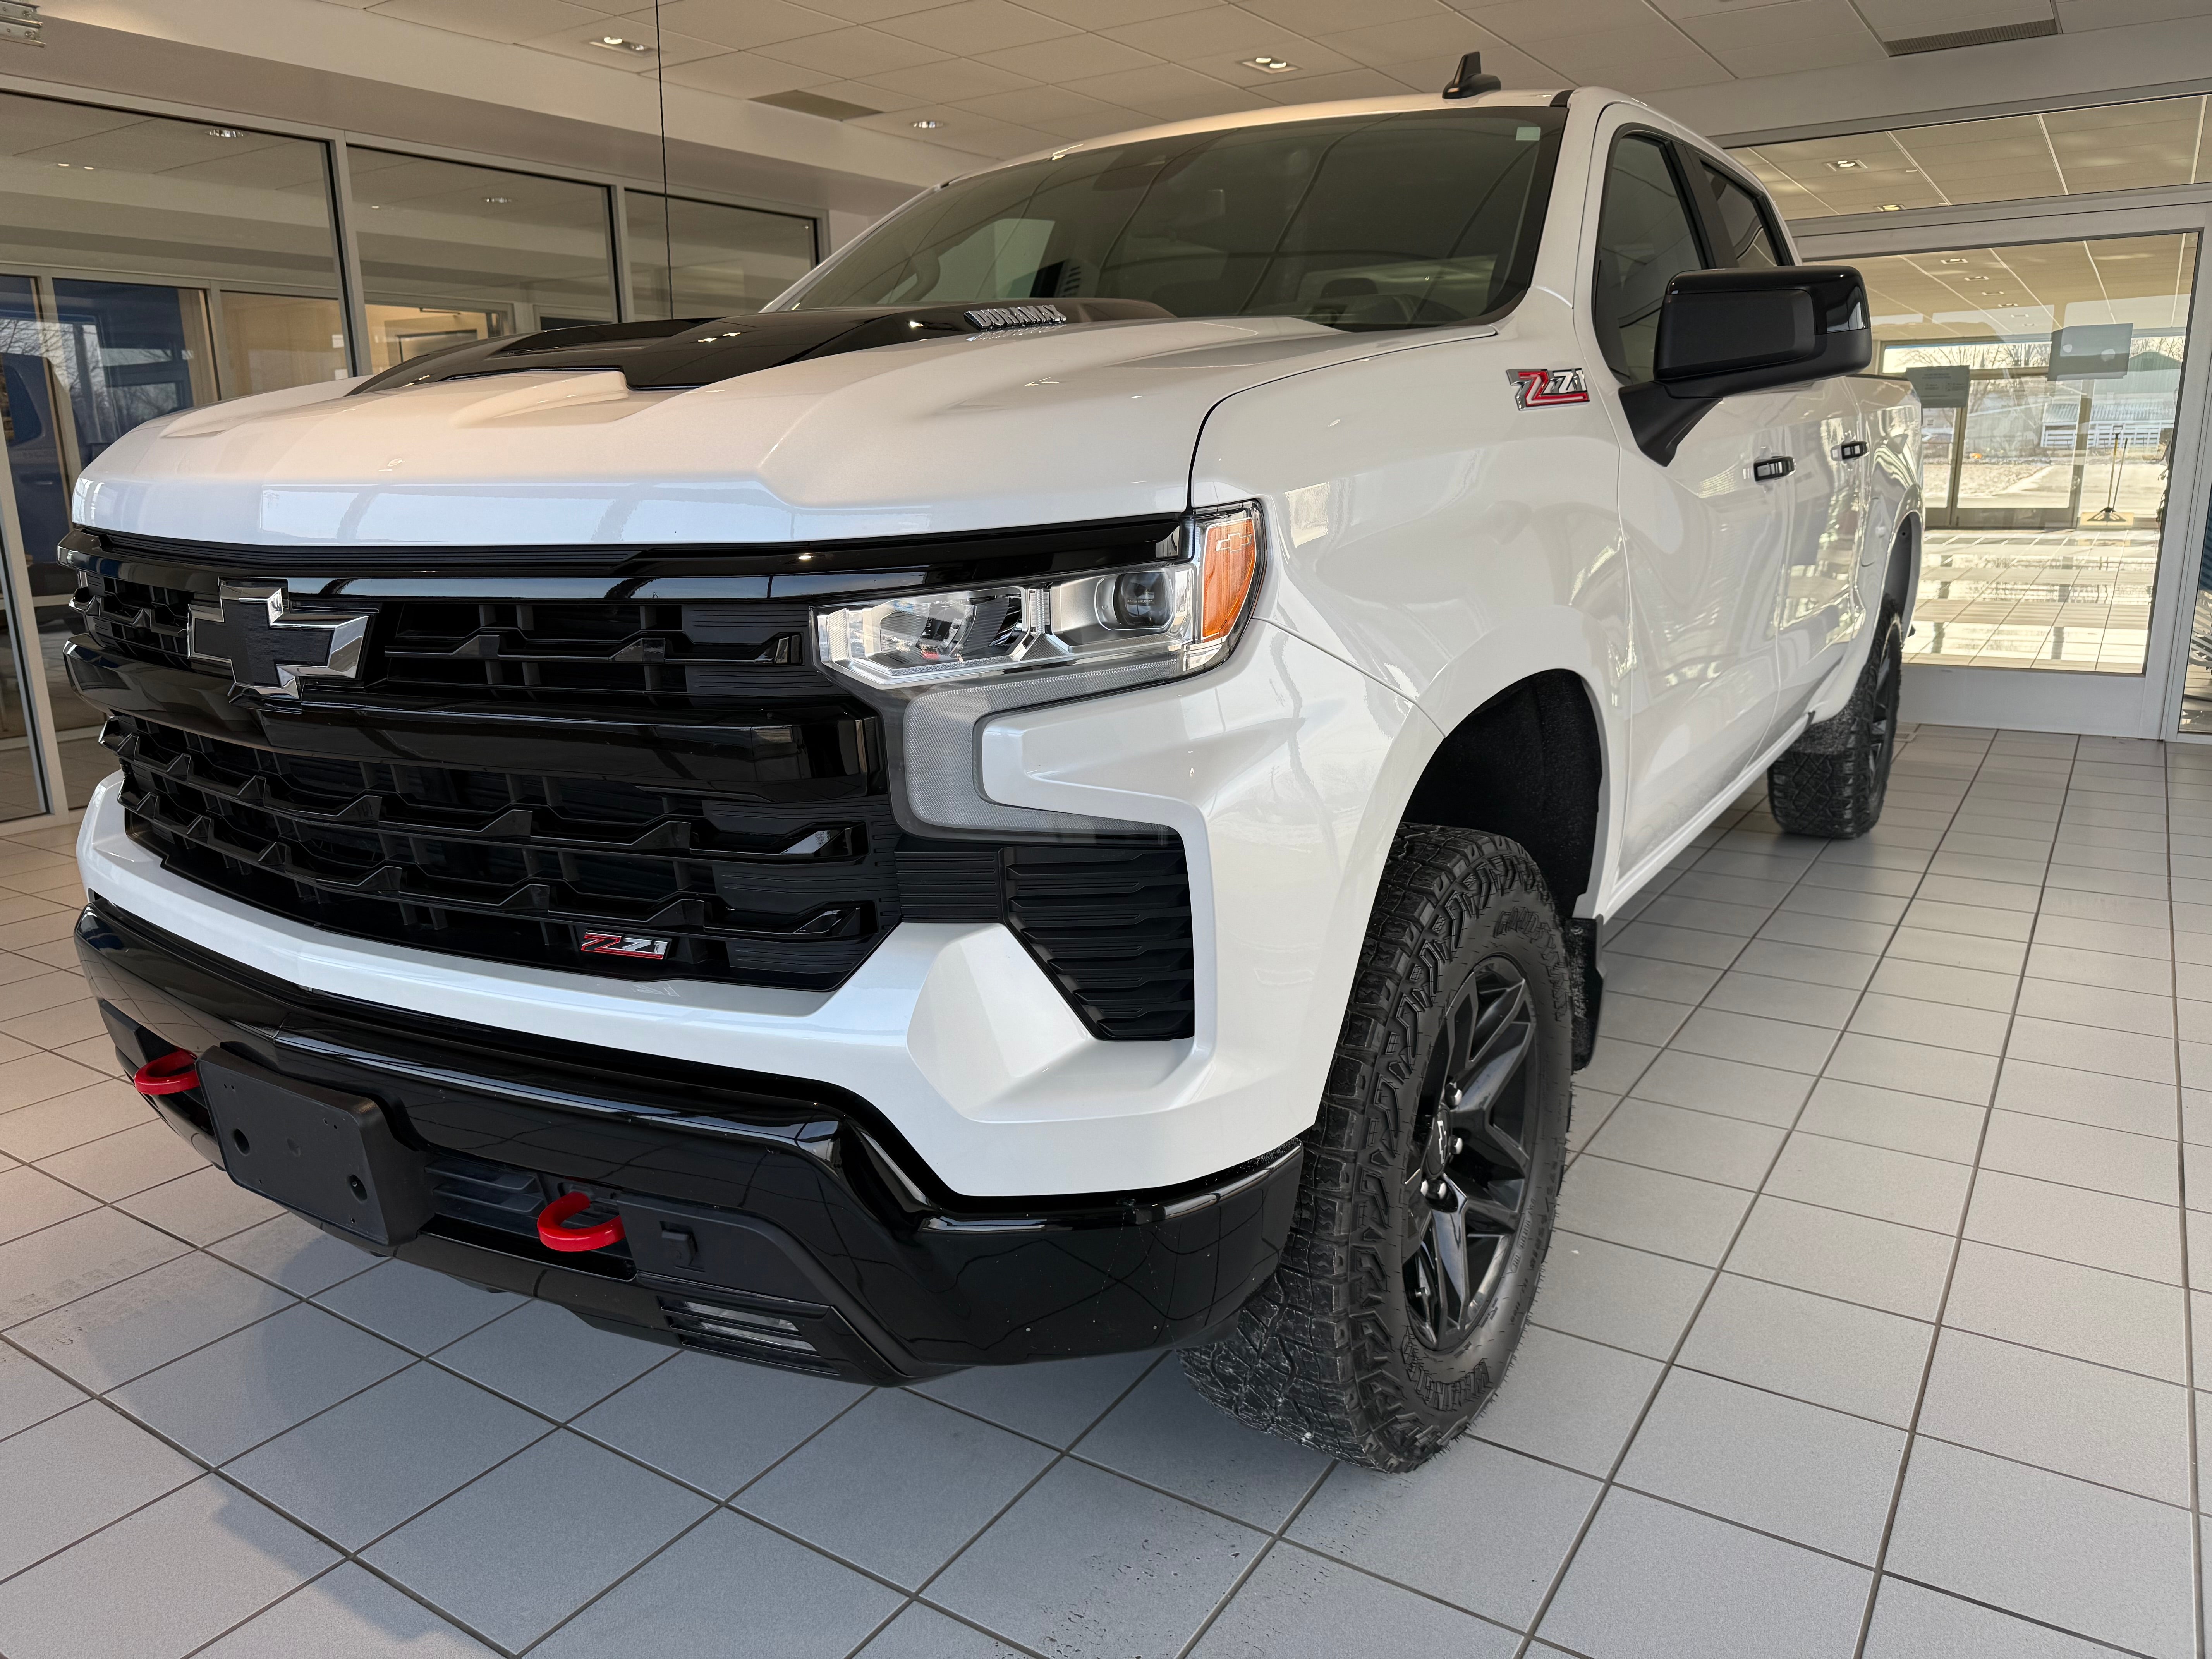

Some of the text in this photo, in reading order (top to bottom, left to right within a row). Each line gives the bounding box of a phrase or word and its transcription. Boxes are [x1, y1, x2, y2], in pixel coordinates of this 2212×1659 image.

[964, 304, 1067, 331] DURAMAX
[1506, 368, 1590, 411] Z71
[581, 931, 668, 960] Z71
